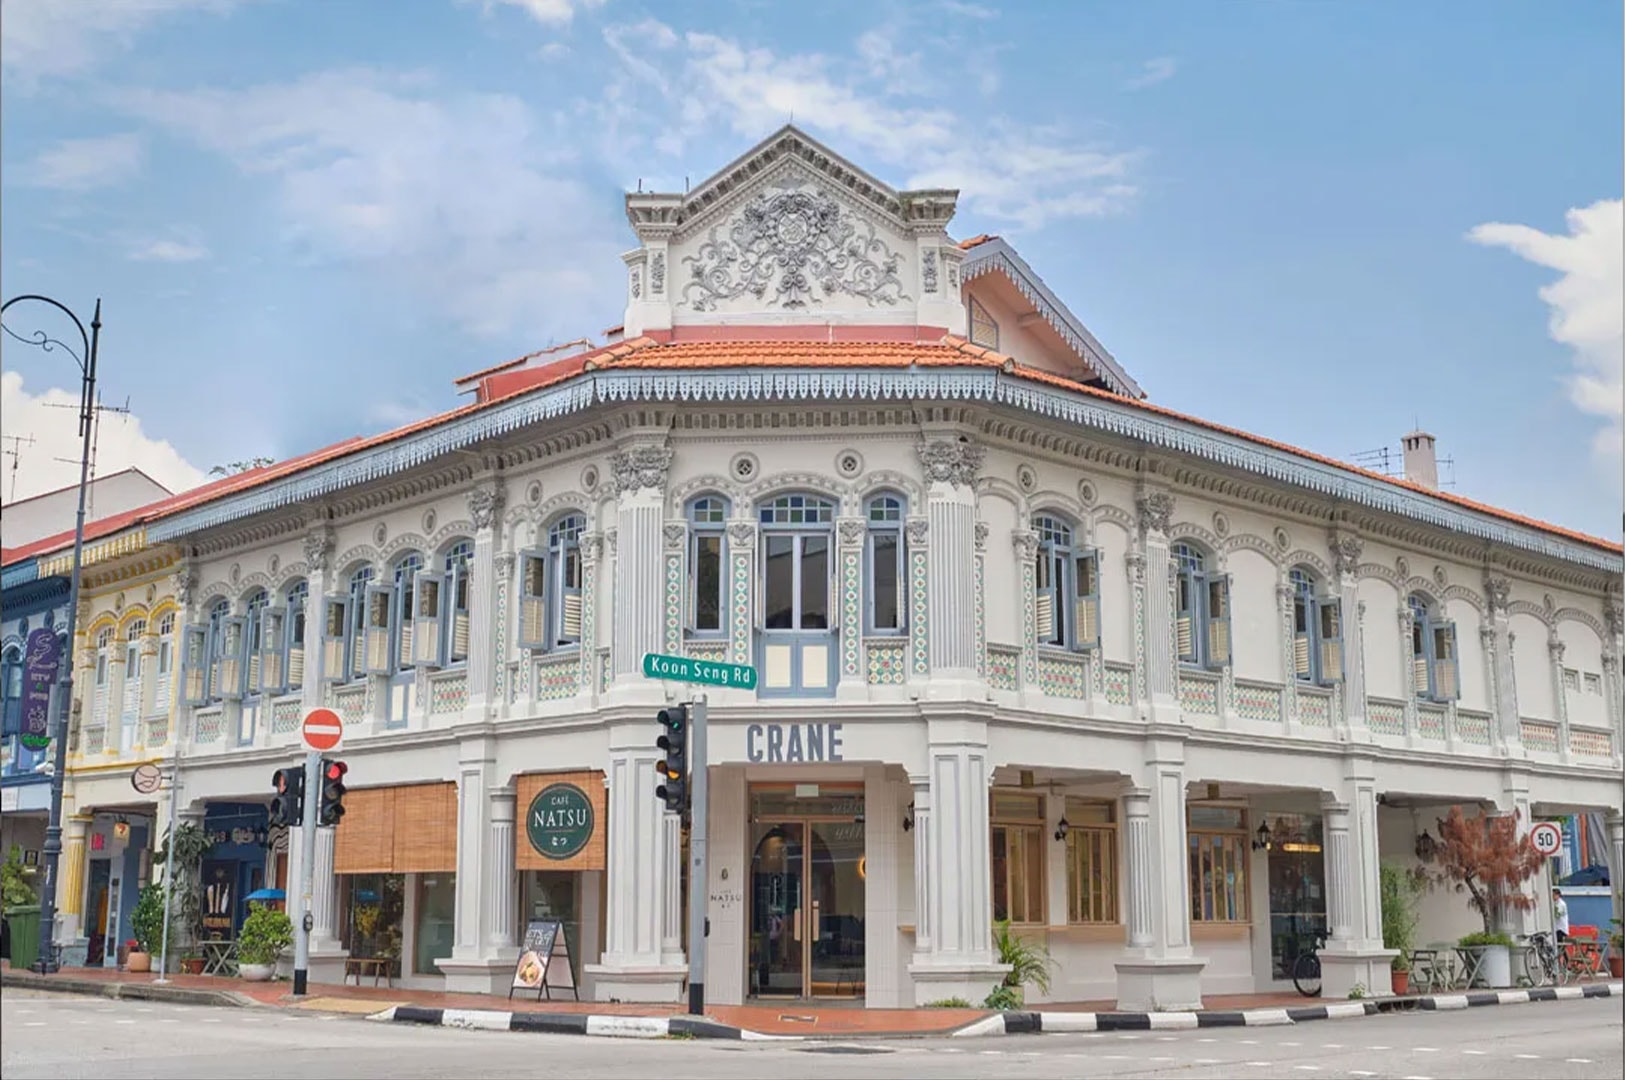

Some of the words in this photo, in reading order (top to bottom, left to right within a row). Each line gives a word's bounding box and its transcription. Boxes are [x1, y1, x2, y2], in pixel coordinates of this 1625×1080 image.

[651, 656, 688, 675] Koon
[694, 662, 728, 684] Seng
[733, 667, 750, 683] Rd
[746, 723, 843, 762] CRANE
[534, 809, 586, 827] NATSU
[1538, 833, 1553, 846] 50
